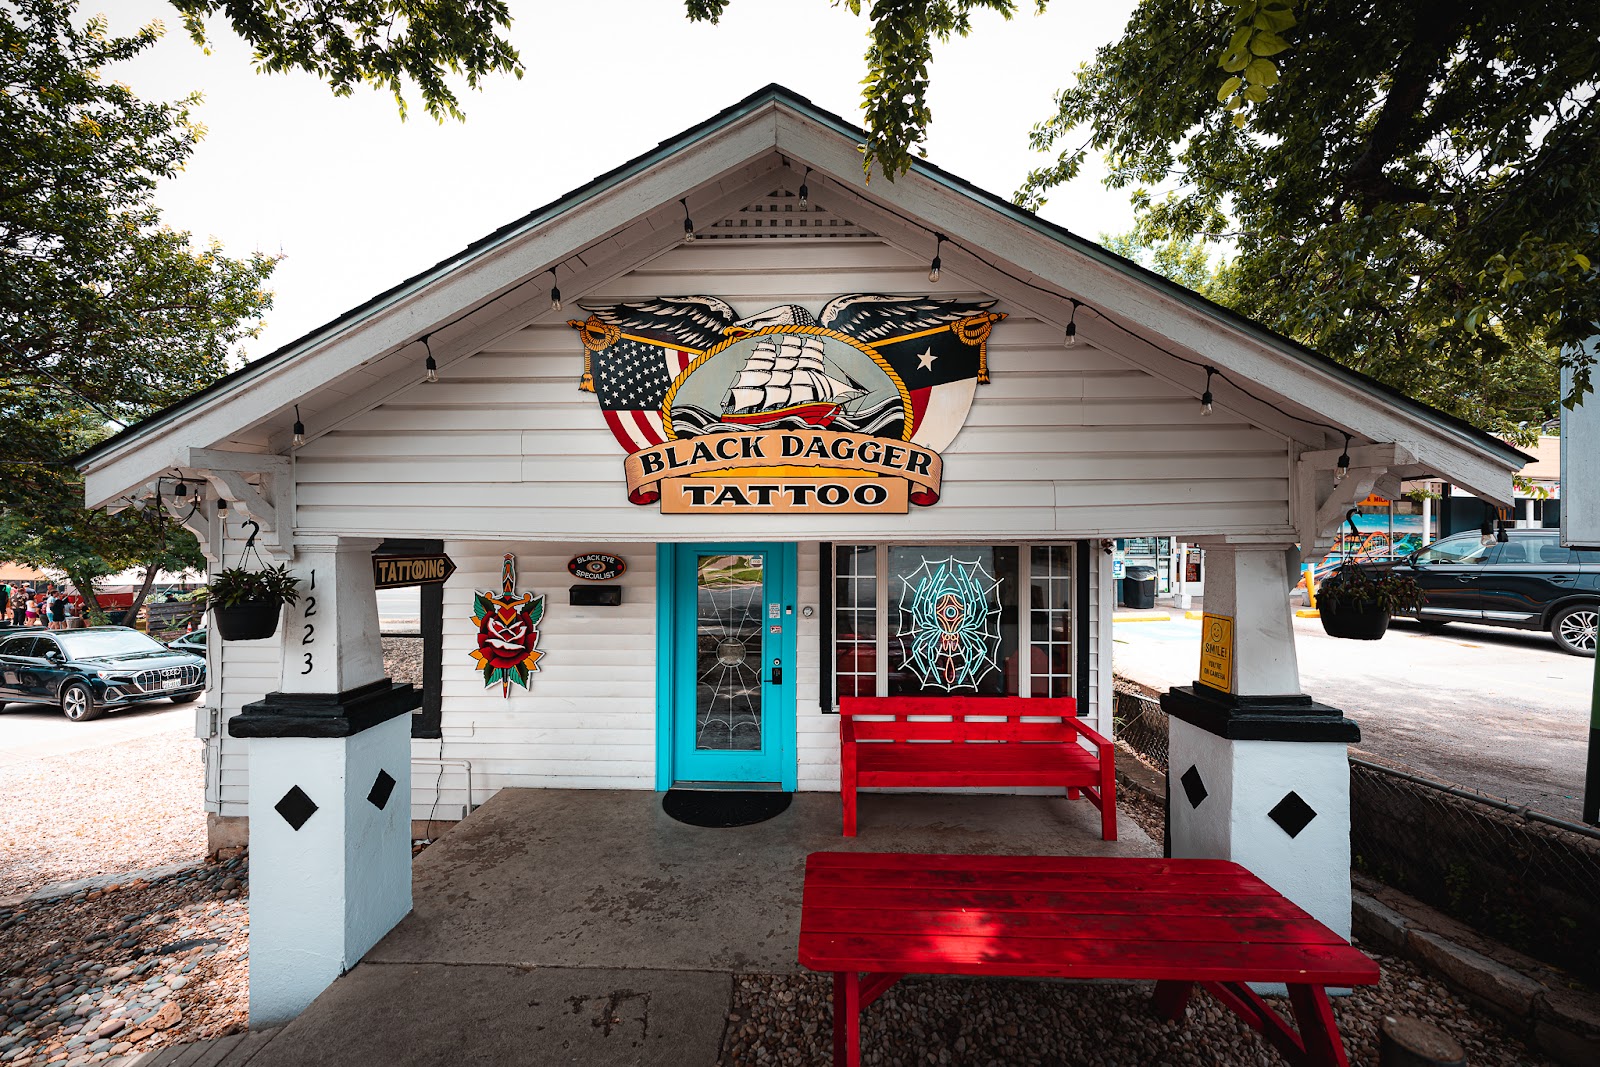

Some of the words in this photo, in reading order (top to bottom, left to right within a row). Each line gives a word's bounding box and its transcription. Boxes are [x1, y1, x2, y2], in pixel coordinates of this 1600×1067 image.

[639, 435, 765, 477] BLACK
[780, 435, 933, 475] DAGGER
[683, 485, 888, 506] TATTOO
[577, 555, 600, 564] BLACK
[601, 555, 615, 564] EYE
[379, 559, 445, 582] TATTOOING
[576, 570, 615, 580] SPECIALIST
[1205, 642, 1227, 658] SMILE!
